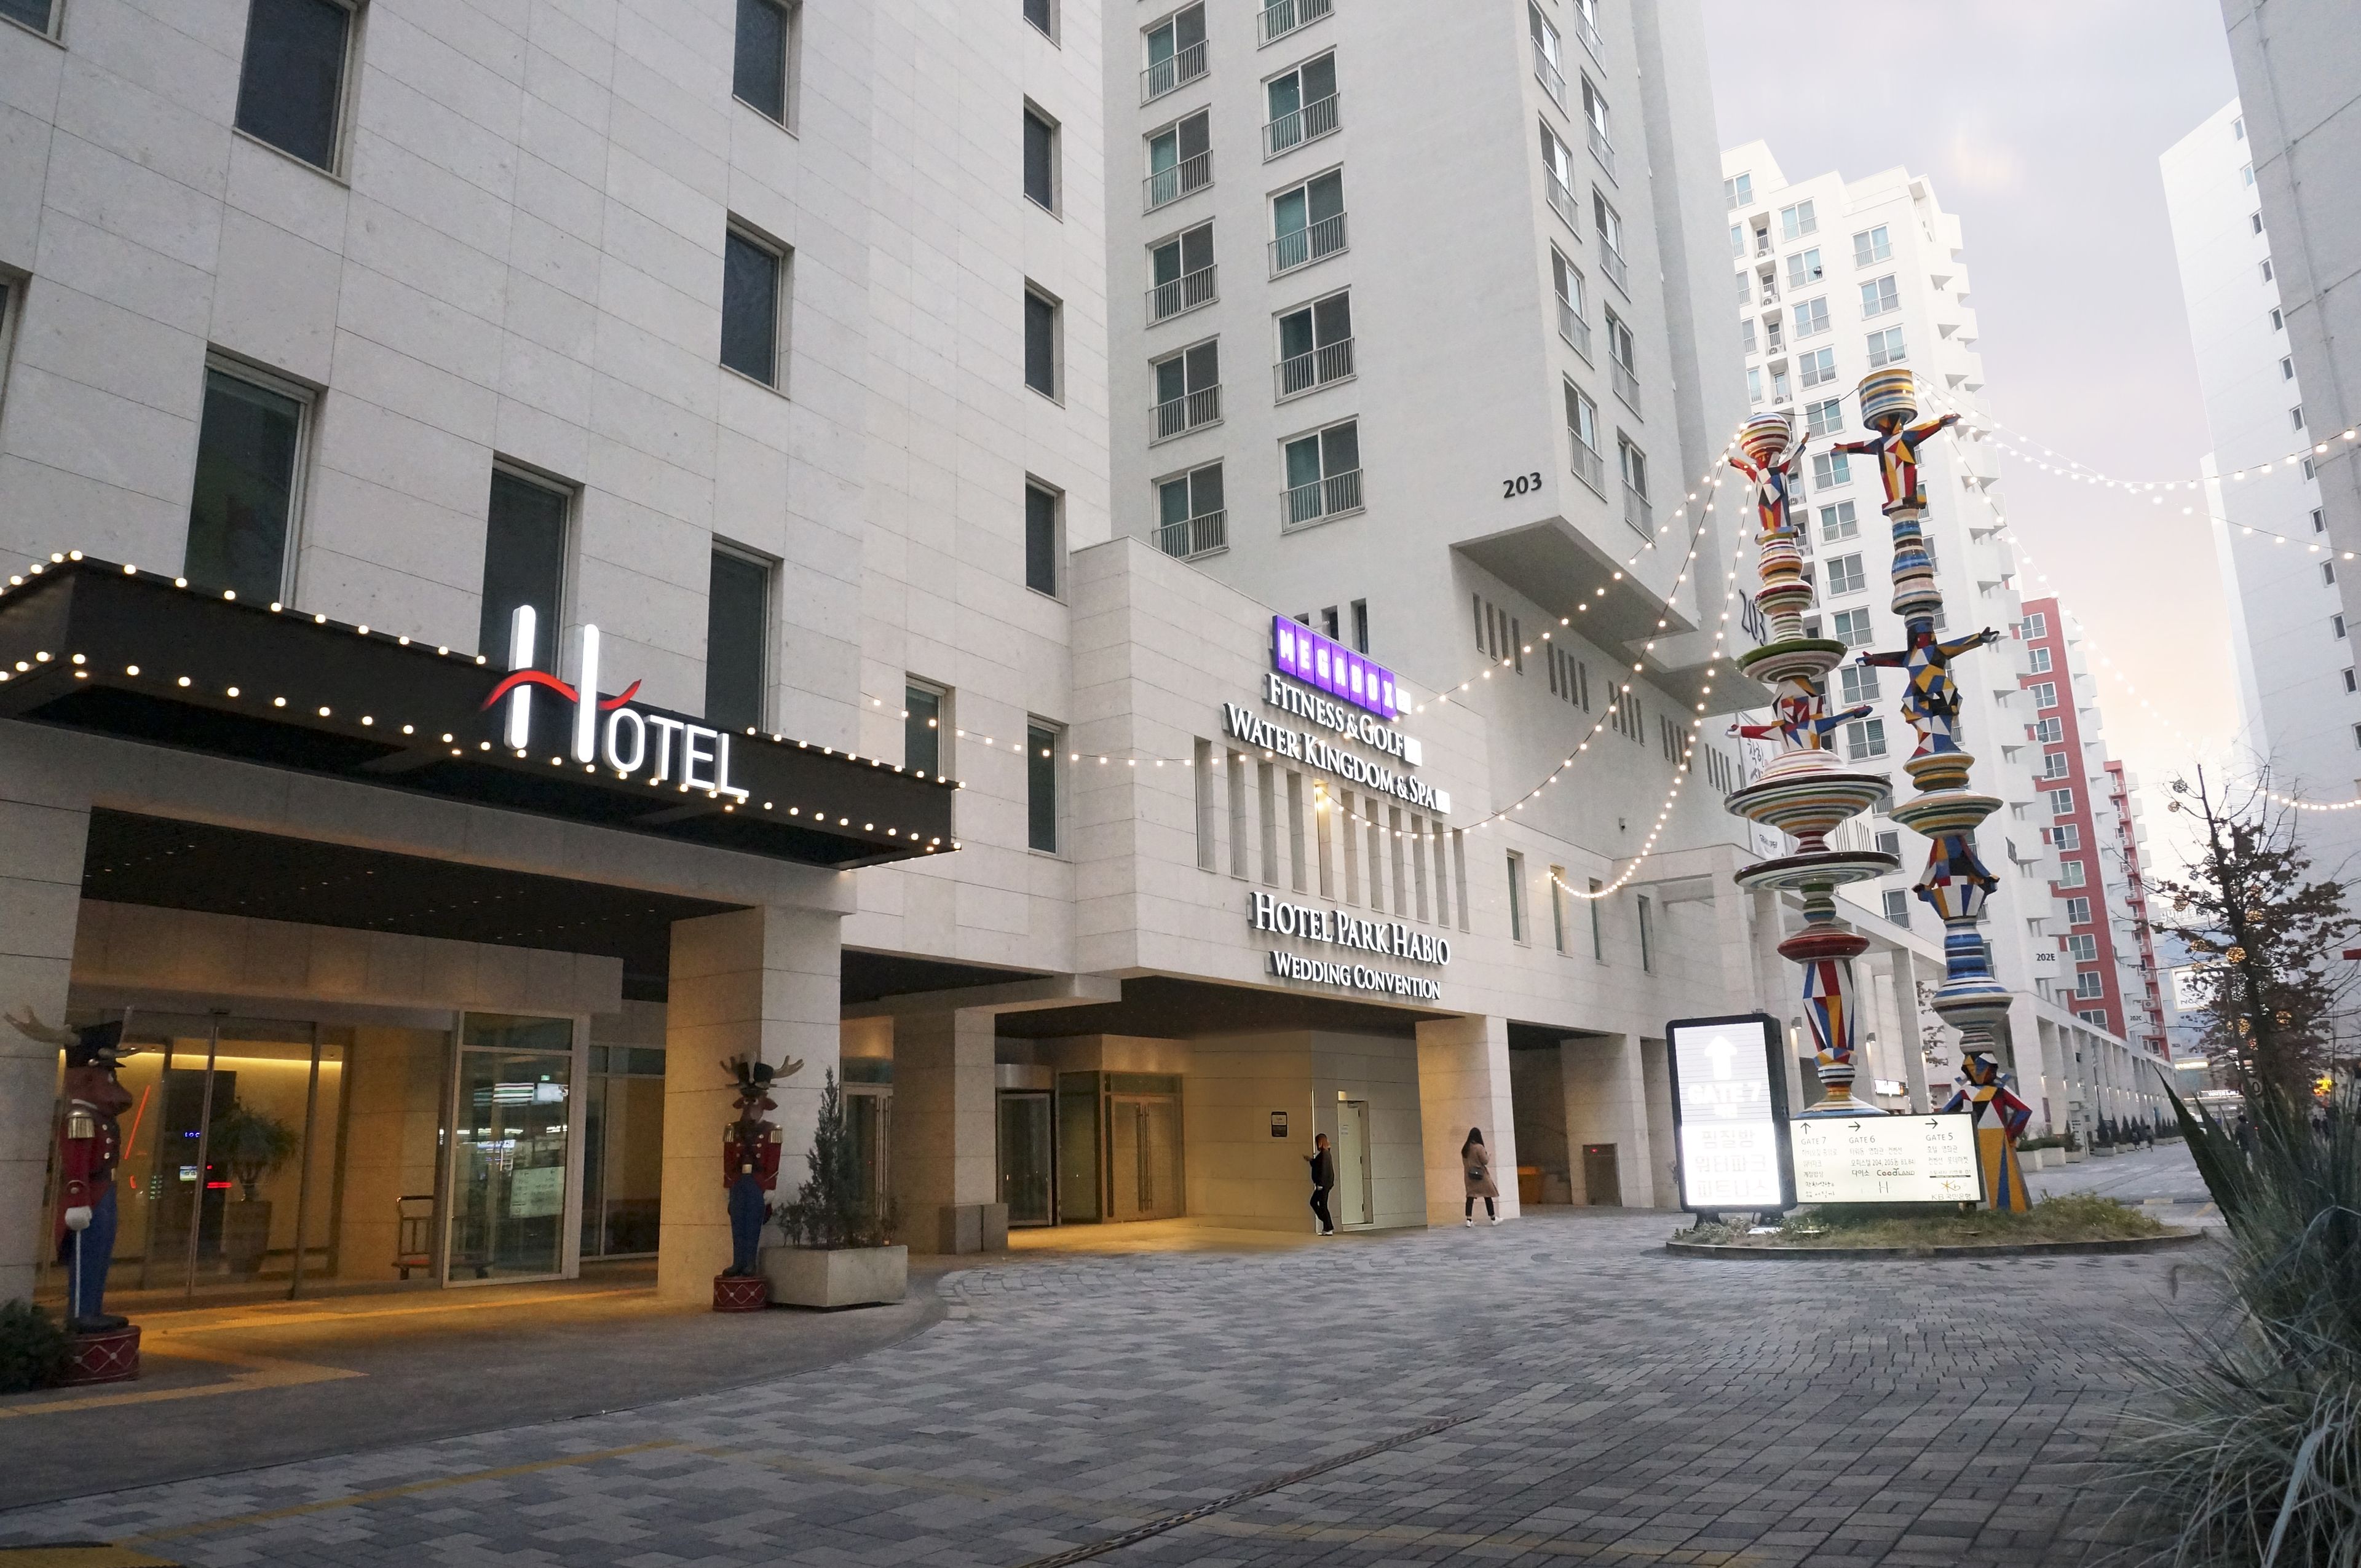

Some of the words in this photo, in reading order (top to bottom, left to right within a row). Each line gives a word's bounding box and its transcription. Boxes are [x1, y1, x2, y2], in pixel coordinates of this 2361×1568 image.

[1503, 472, 1542, 498] 203
[1279, 629, 1394, 709] MEGABOX
[480, 604, 749, 798] HOTEL
[1268, 672, 1345, 732] FITNESS
[1346, 713, 1361, 739] &
[1359, 714, 1405, 757] GOLF
[1226, 702, 1301, 759] WATER
[1303, 732, 1394, 795] KINGDOM
[1396, 775, 1409, 799] &
[1409, 774, 1437, 810] SPA
[1252, 891, 1333, 943] HOTEL
[1334, 909, 1390, 955] PARK
[1390, 923, 1451, 966] HABIO
[1271, 950, 1351, 987] WEDDING
[1353, 964, 1441, 1000] CONVENTION
[2036, 953, 2056, 961] 202E
[1687, 1082, 1744, 1105] GATE
[1747, 1081, 1762, 1102] 7
[1695, 1153, 1768, 1173] 워터파크
[1696, 1179, 1771, 1198] 피트니스
